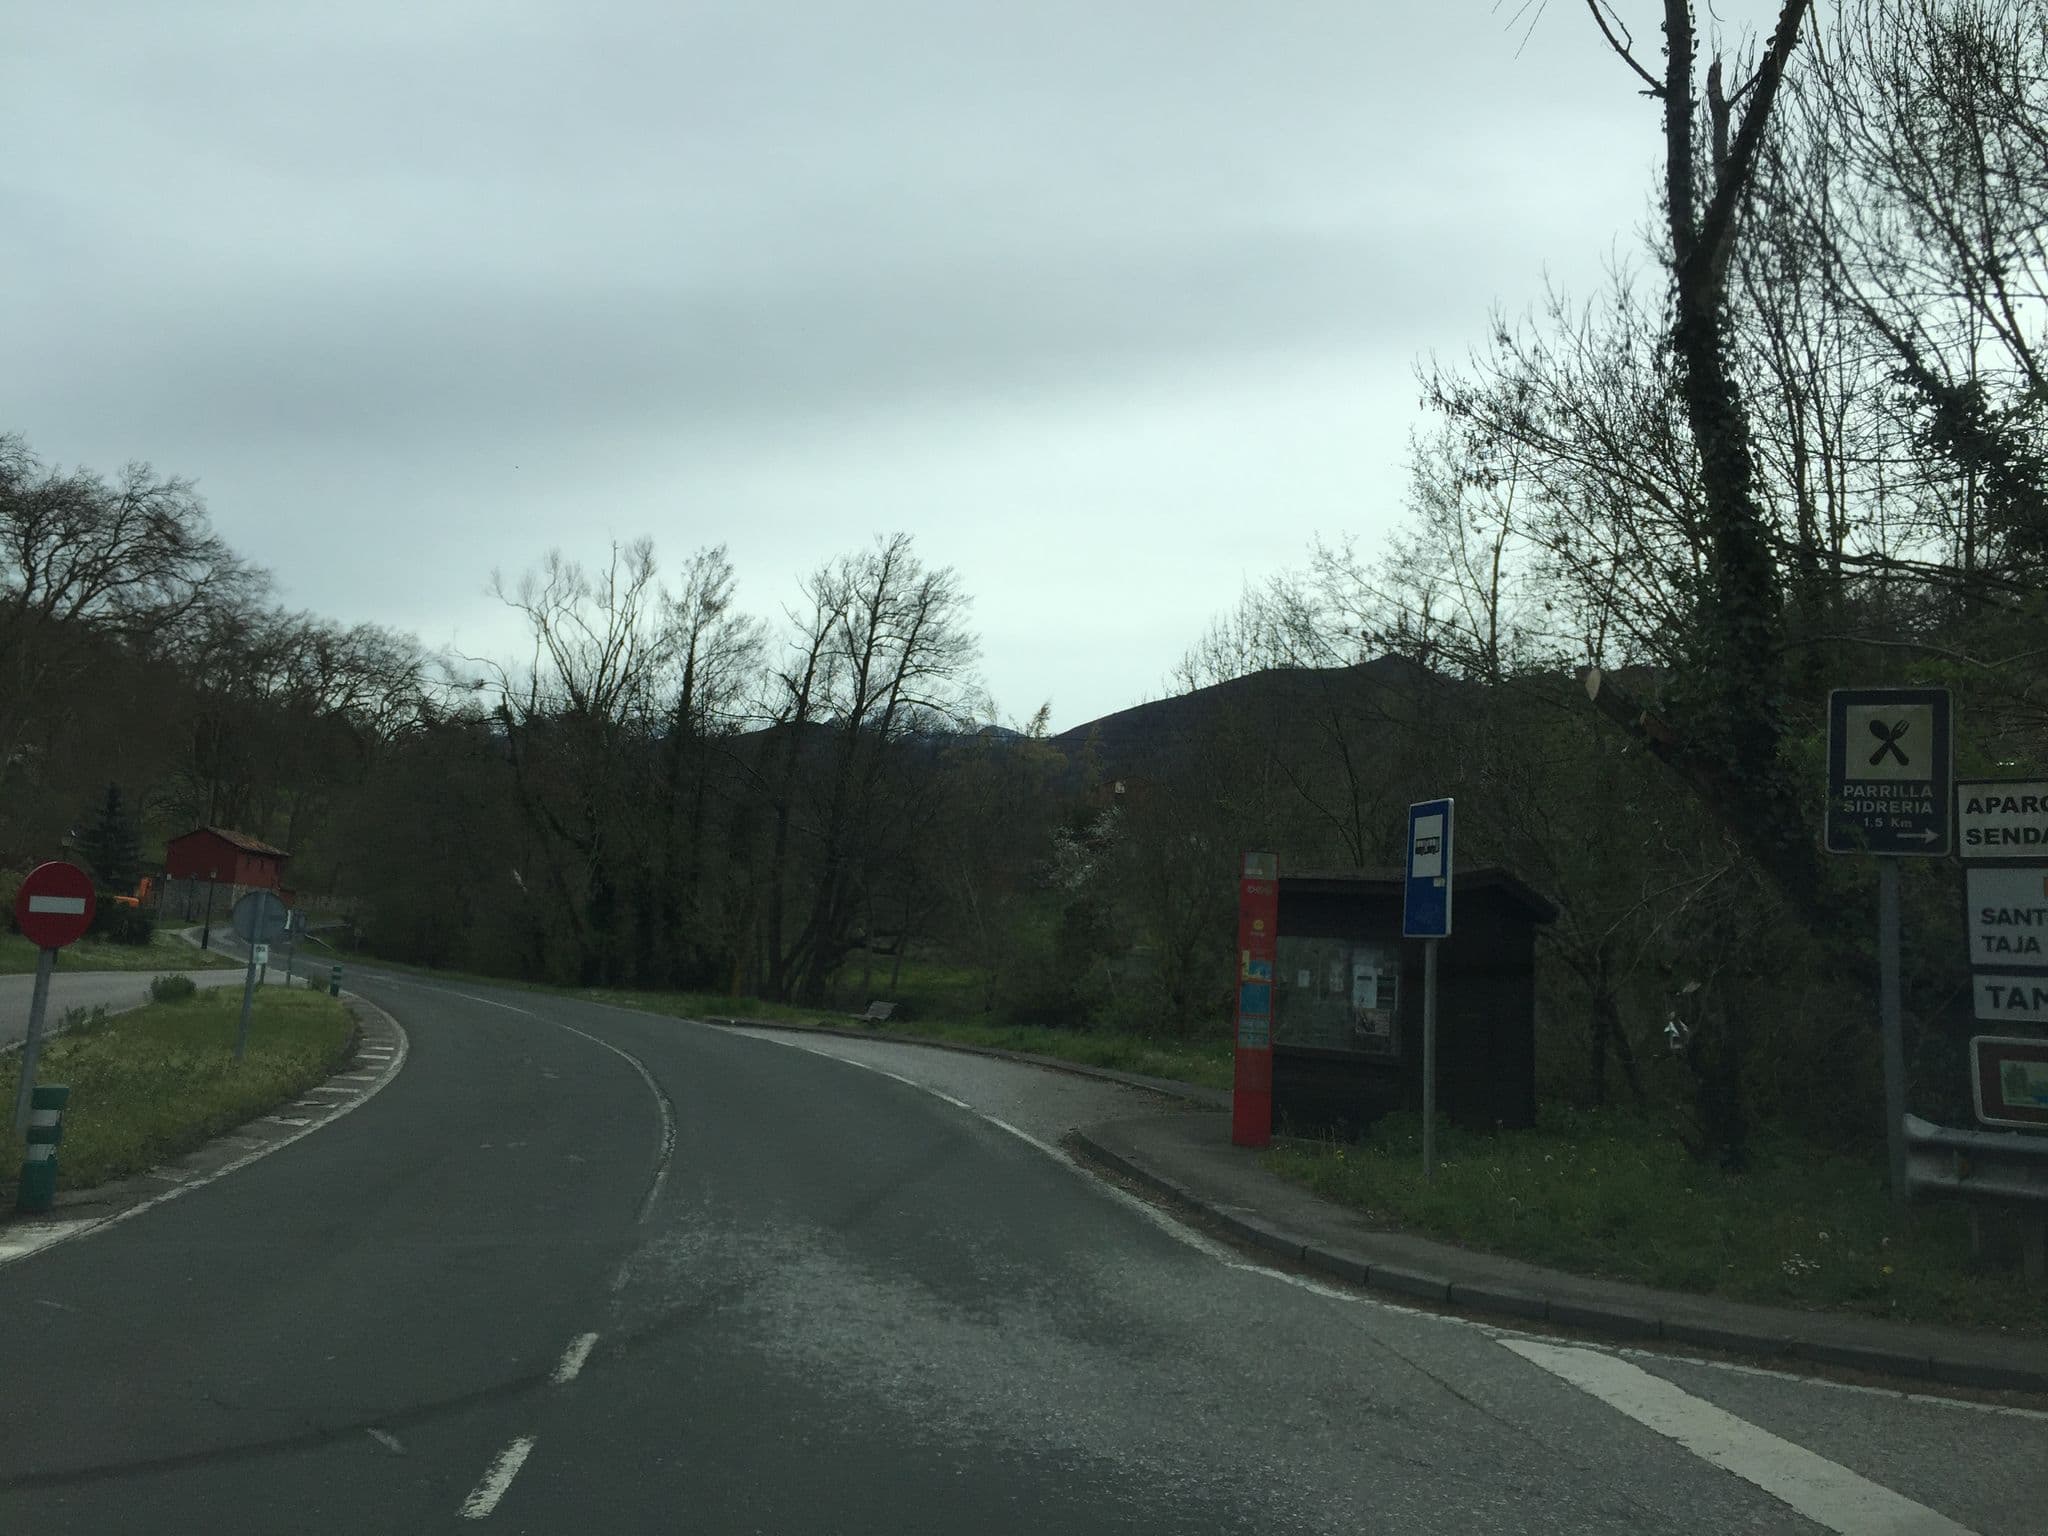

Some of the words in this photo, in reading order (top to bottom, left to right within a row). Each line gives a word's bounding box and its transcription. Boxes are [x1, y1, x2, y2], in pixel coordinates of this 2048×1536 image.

[1843, 784, 1934, 798] PARRILLA
[1842, 800, 1934, 815] SIDRERIA
[1981, 935, 2041, 954] TAJA
